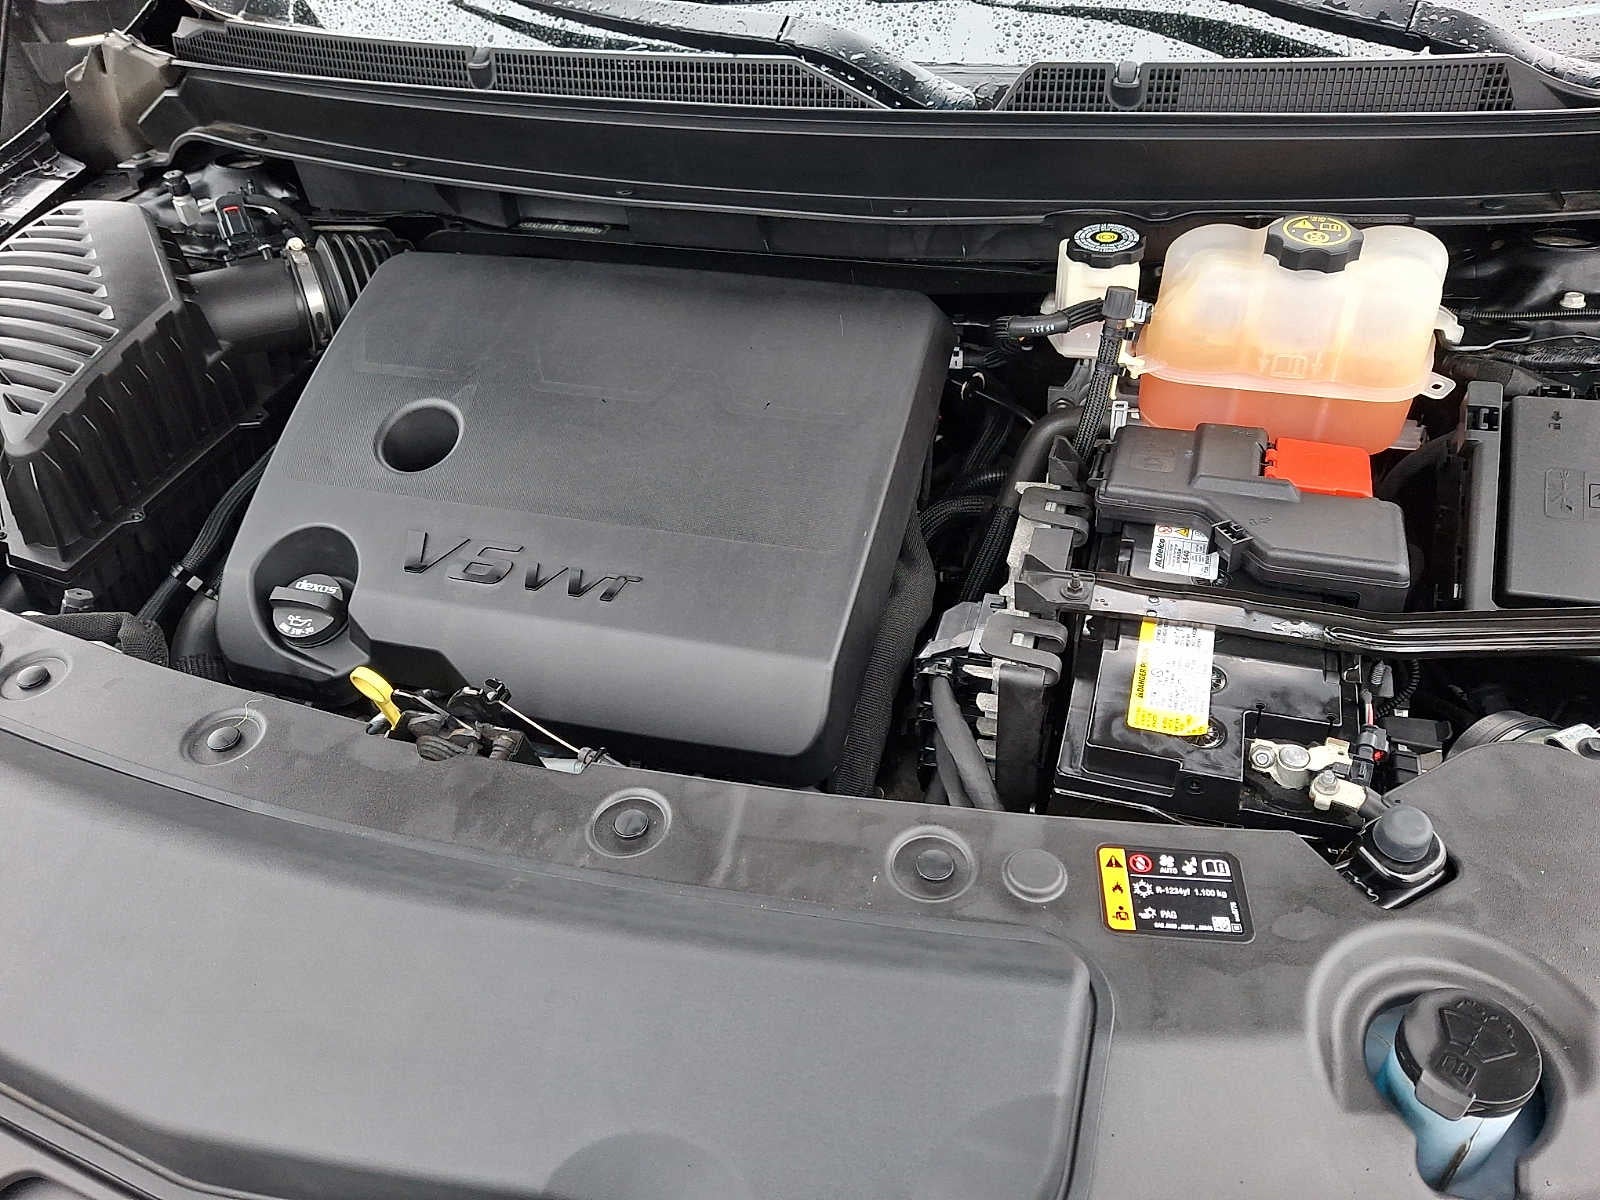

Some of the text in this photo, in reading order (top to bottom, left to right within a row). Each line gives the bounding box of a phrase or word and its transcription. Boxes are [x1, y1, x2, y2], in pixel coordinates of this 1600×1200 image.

[403, 529, 526, 585] V6
[295, 579, 338, 594] dexos
[1159, 866, 1179, 875] AUTO
[1193, 888, 1216, 897] 1.100
[1216, 890, 1228, 899] kg
[1159, 909, 1178, 919] PAG
